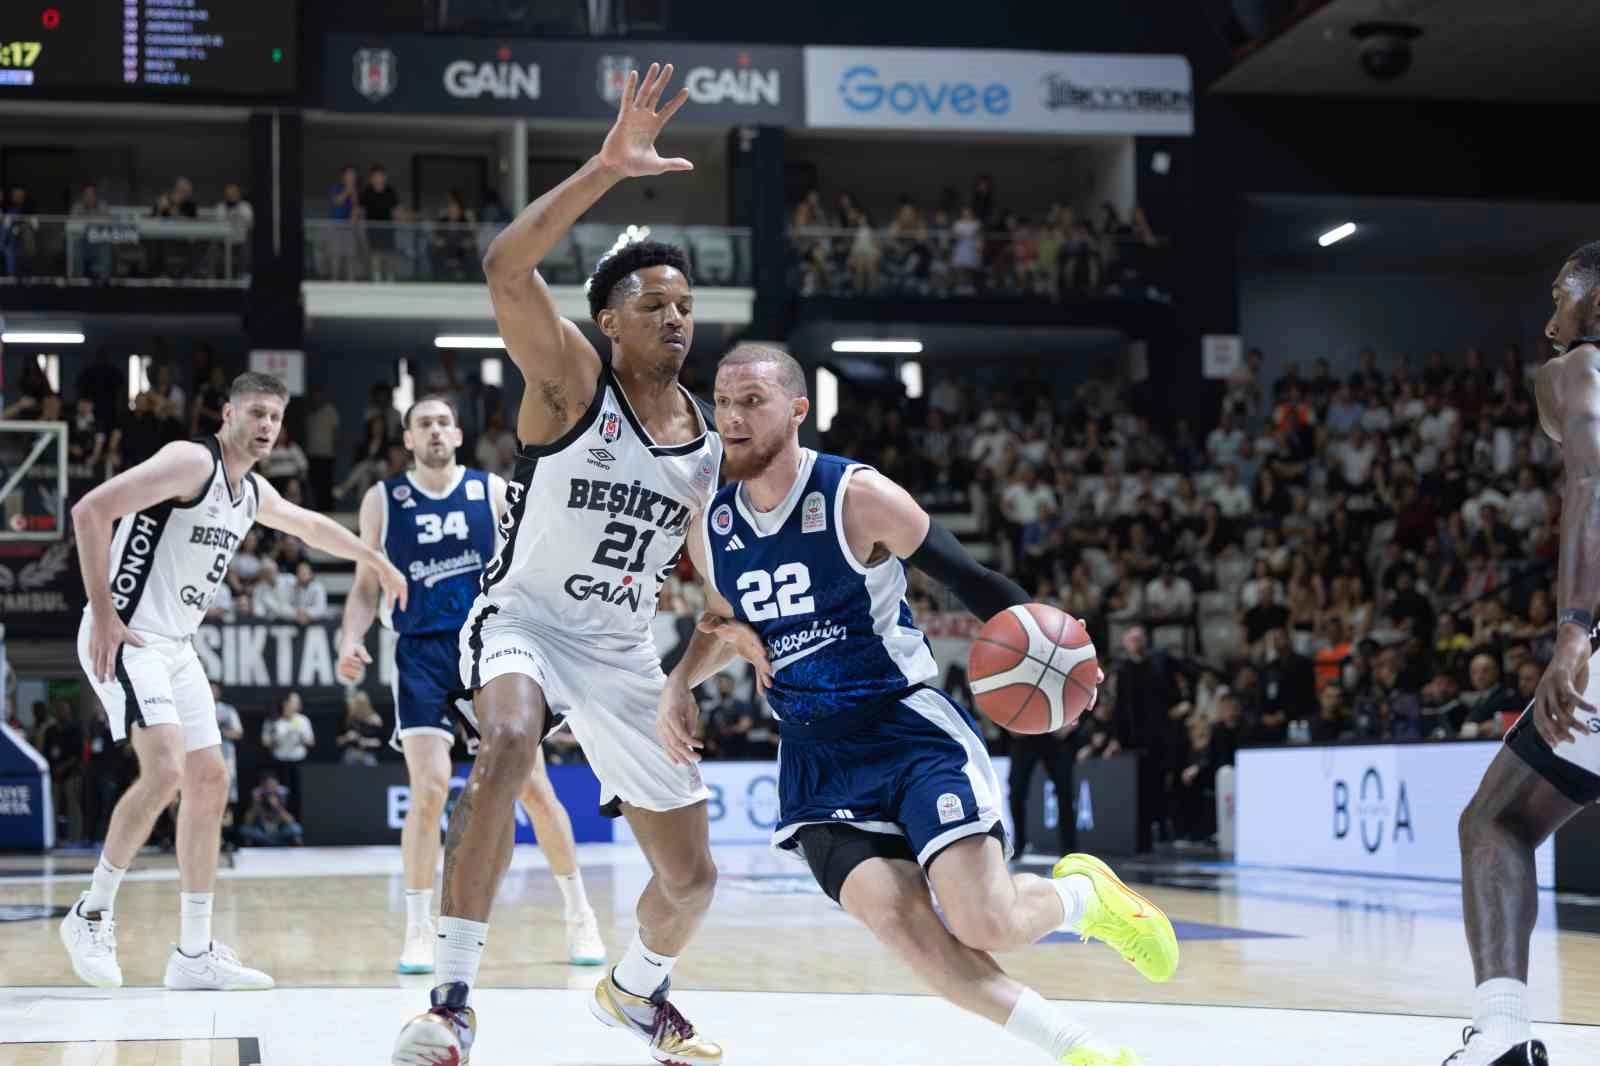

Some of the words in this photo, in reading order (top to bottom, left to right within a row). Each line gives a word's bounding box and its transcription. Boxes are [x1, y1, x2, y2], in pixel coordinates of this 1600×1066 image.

[0, 42, 41, 67] :17
[839, 65, 1010, 114] Govee
[415, 511, 470, 544] 34
[592, 521, 656, 573] 21
[111, 514, 158, 611] HONOR
[736, 562, 816, 622] 22
[1044, 779, 1095, 831] BA
[1333, 767, 1416, 853] BOA
